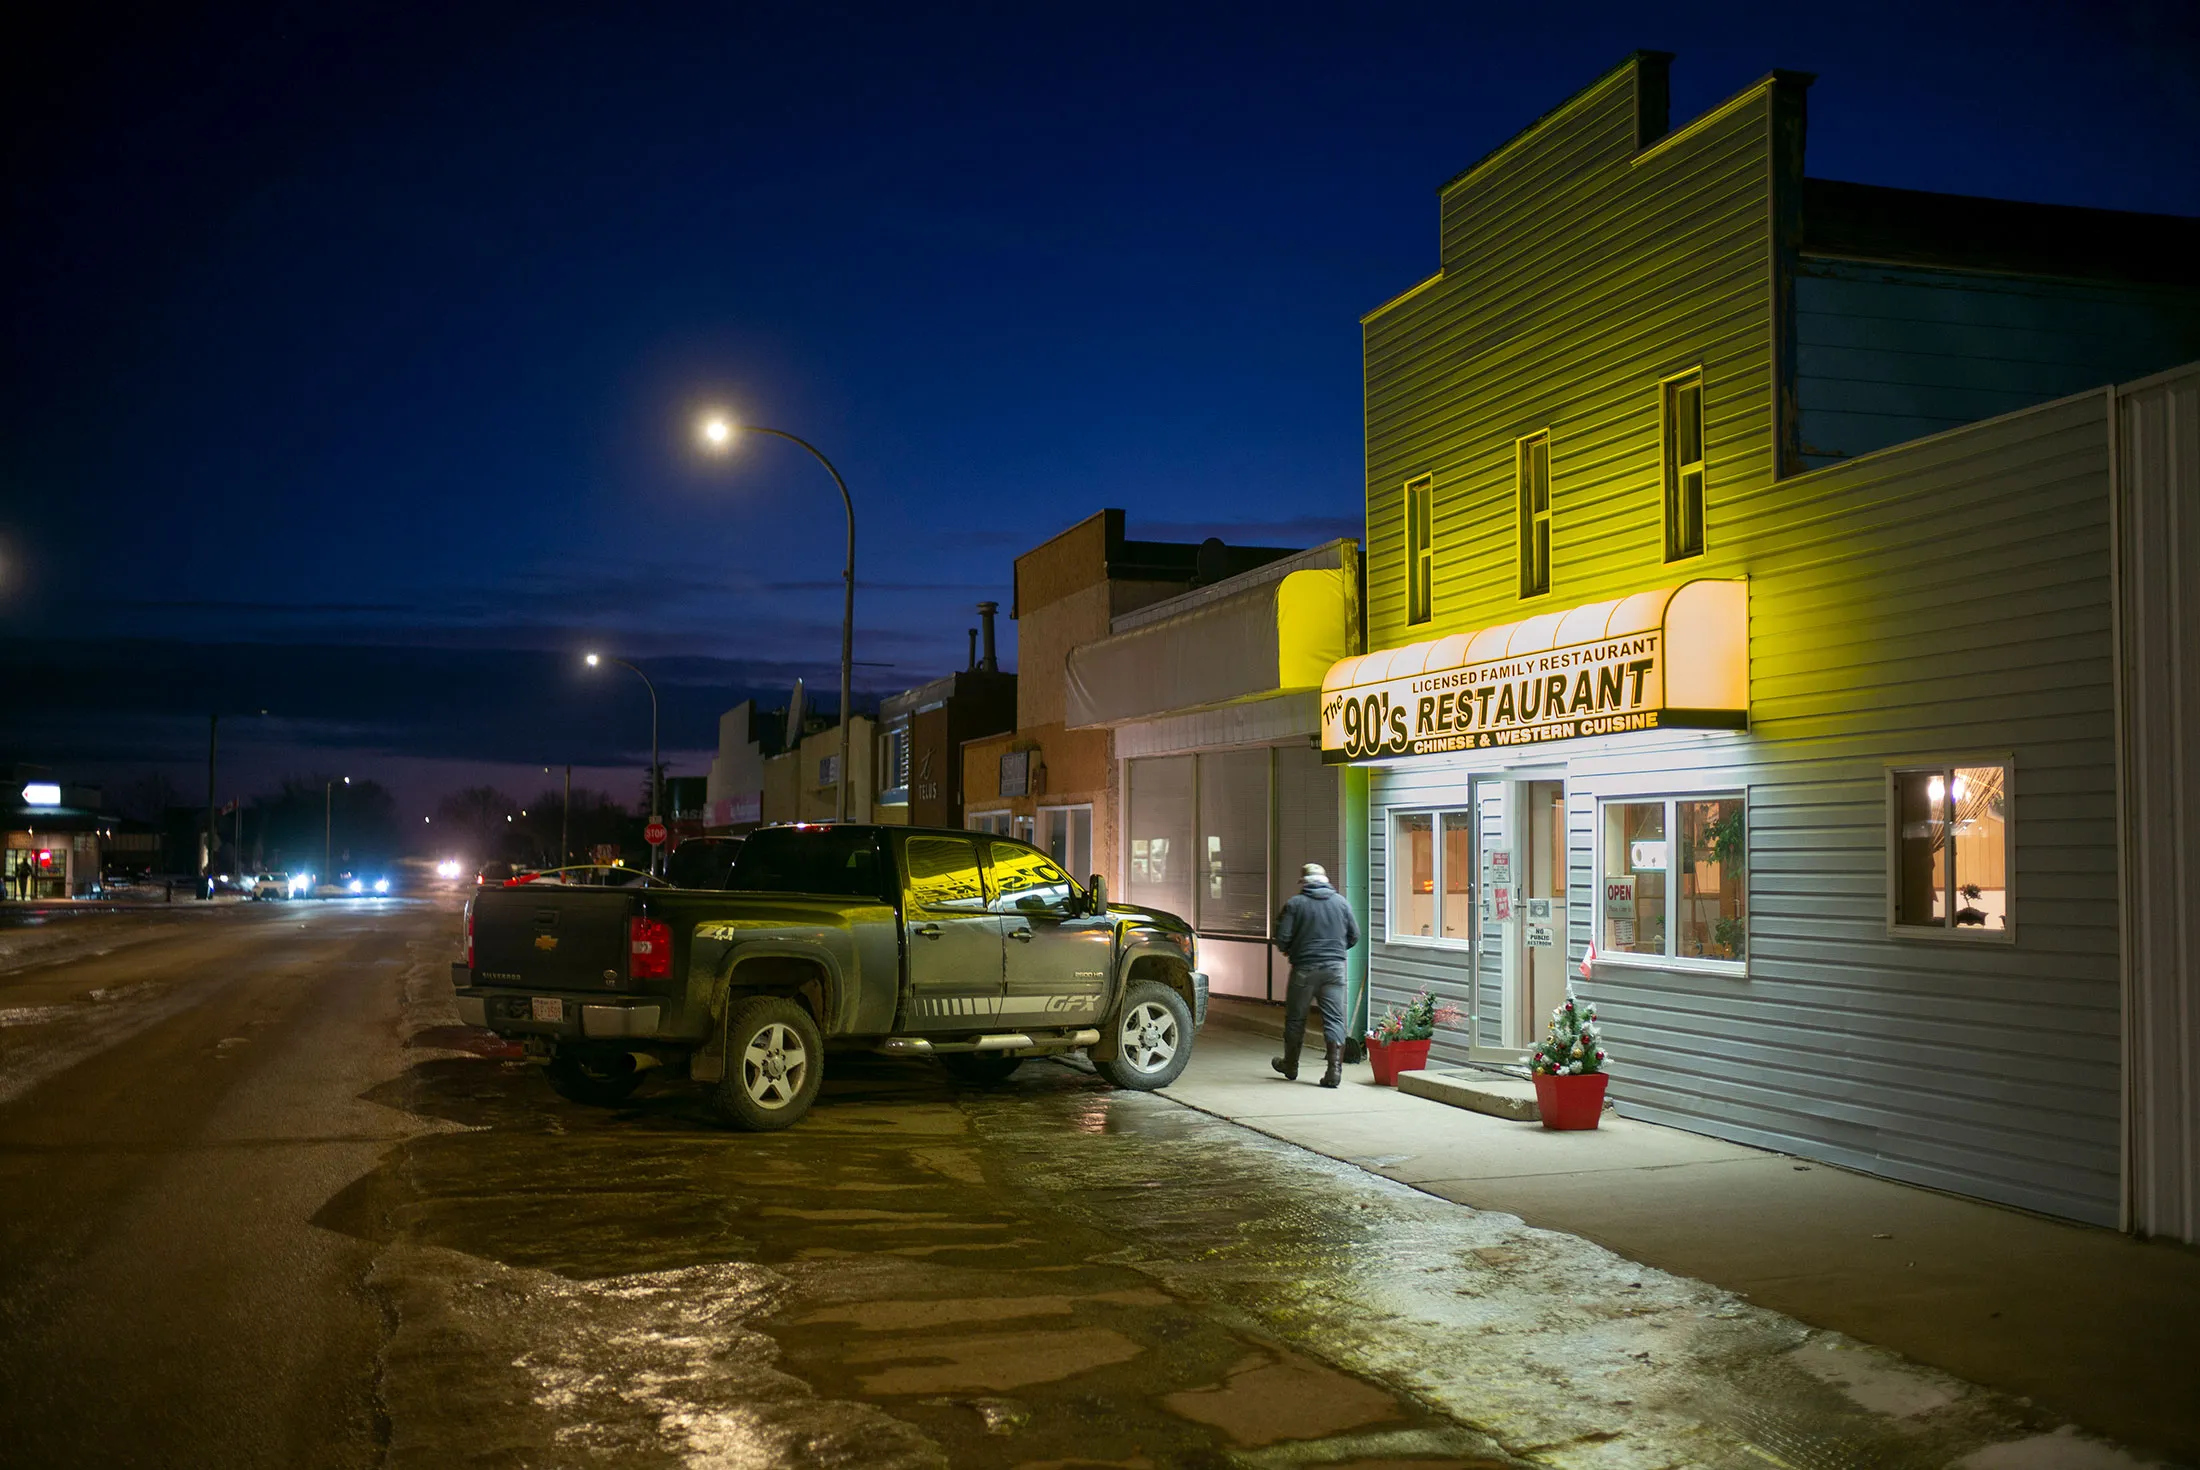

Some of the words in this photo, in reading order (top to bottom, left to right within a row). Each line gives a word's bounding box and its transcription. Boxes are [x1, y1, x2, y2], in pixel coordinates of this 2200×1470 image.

[1412, 671, 1477, 694] LICENSED
[1481, 660, 1535, 682] FAMILY
[1540, 637, 1657, 671] RESTAURANT
[1323, 694, 1343, 726] The
[1415, 658, 1654, 738] RESTAURANT
[1414, 734, 1475, 755] CHINESE
[1479, 732, 1491, 748] &
[1496, 722, 1576, 746] WESTERN
[1580, 712, 1659, 736] CUISINE
[918, 782, 937, 801] TELUS
[646, 828, 665, 839] STOP
[1607, 884, 1632, 901] OPEN
[481, 972, 522, 981] SILVERADO
[1046, 994, 1101, 1013] GFX
